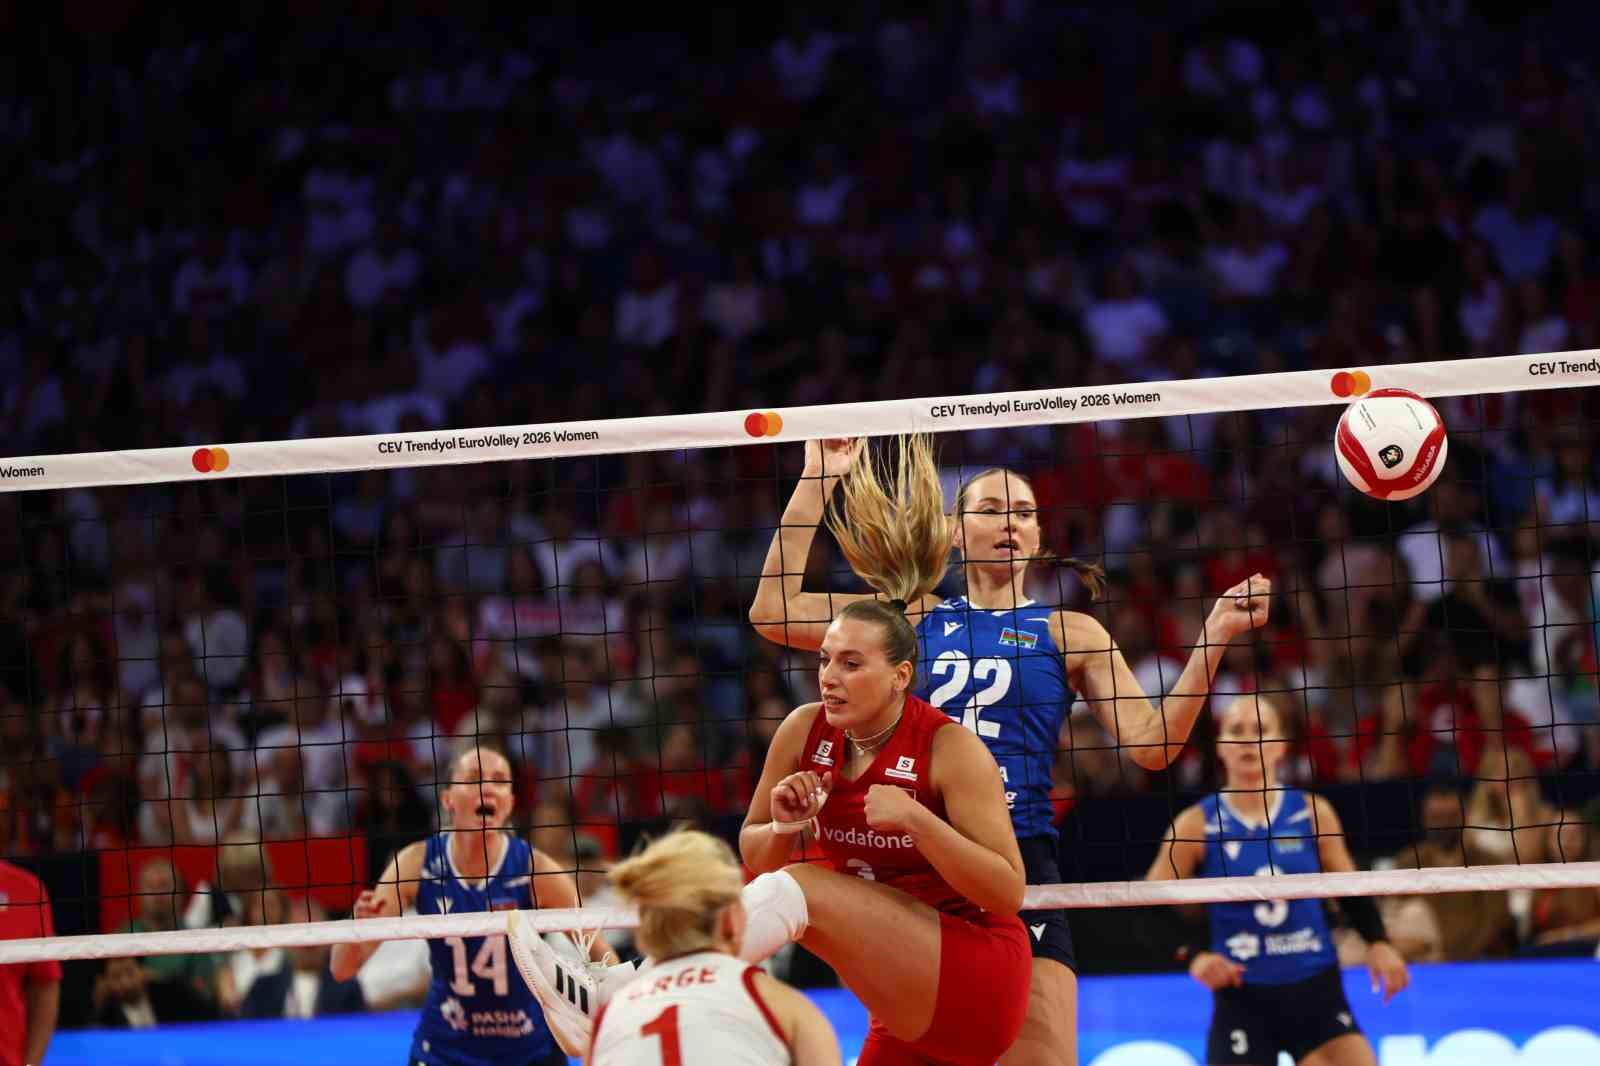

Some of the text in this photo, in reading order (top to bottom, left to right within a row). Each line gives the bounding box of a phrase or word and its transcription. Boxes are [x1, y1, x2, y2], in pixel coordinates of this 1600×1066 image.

[1528, 361, 1556, 375] CEV
[930, 391, 1160, 418] CEV Trendyol EuroVolley 2026 Women
[378, 430, 599, 454] CEV Trendyol EuroVolley 2026 Women
[0, 466, 45, 478] Women
[929, 649, 1012, 738] 22
[823, 827, 913, 849] vodafone
[445, 935, 509, 996] 14
[640, 1004, 684, 1066] 1
[1230, 1029, 1248, 1055] 3
